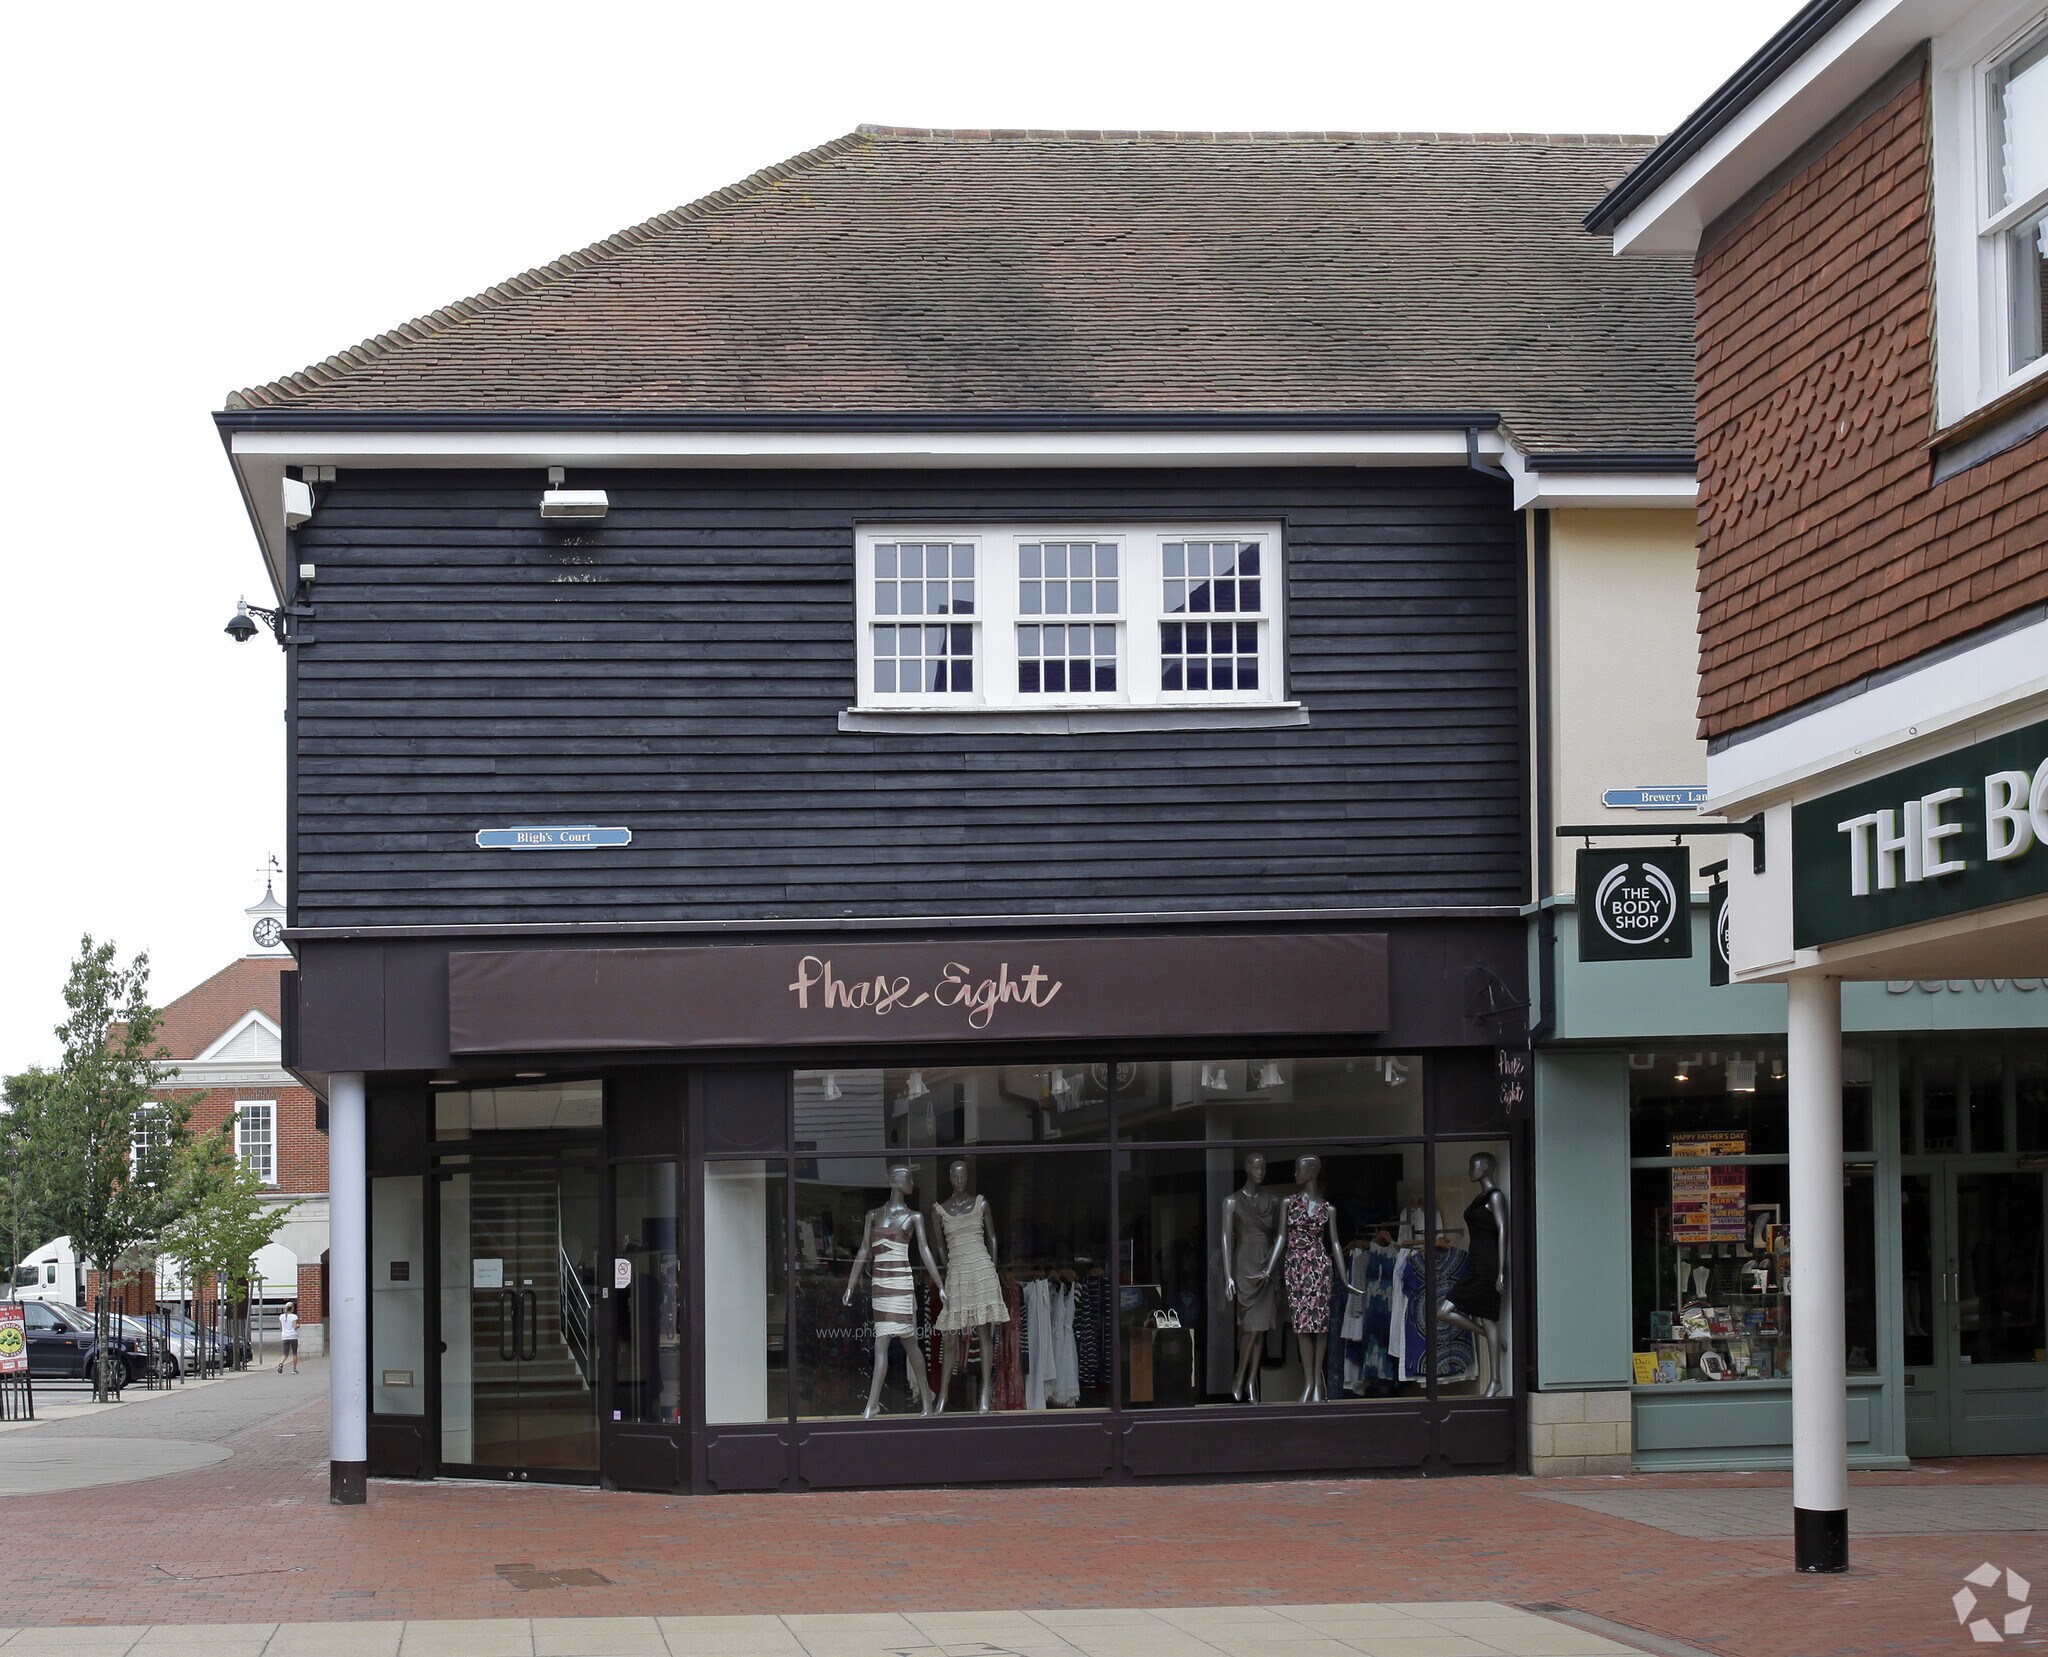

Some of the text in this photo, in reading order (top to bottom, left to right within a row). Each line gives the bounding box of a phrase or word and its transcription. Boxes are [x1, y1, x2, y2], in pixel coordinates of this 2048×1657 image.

[1641, 792, 1682, 804] Brewery
[517, 831, 591, 844] Bligh's Court
[1837, 787, 1967, 896] THE
[1621, 887, 1650, 900] THE
[1612, 900, 1661, 914] BODY
[1616, 915, 1659, 929] SHOP
[789, 955, 1063, 1029] Phase Eight
[1498, 1049, 1525, 1077] Phase
[1500, 1082, 1524, 1114] Eight
[1697, 1132, 1729, 1140] FATHER'S
[1730, 1132, 1745, 1140] DAY
